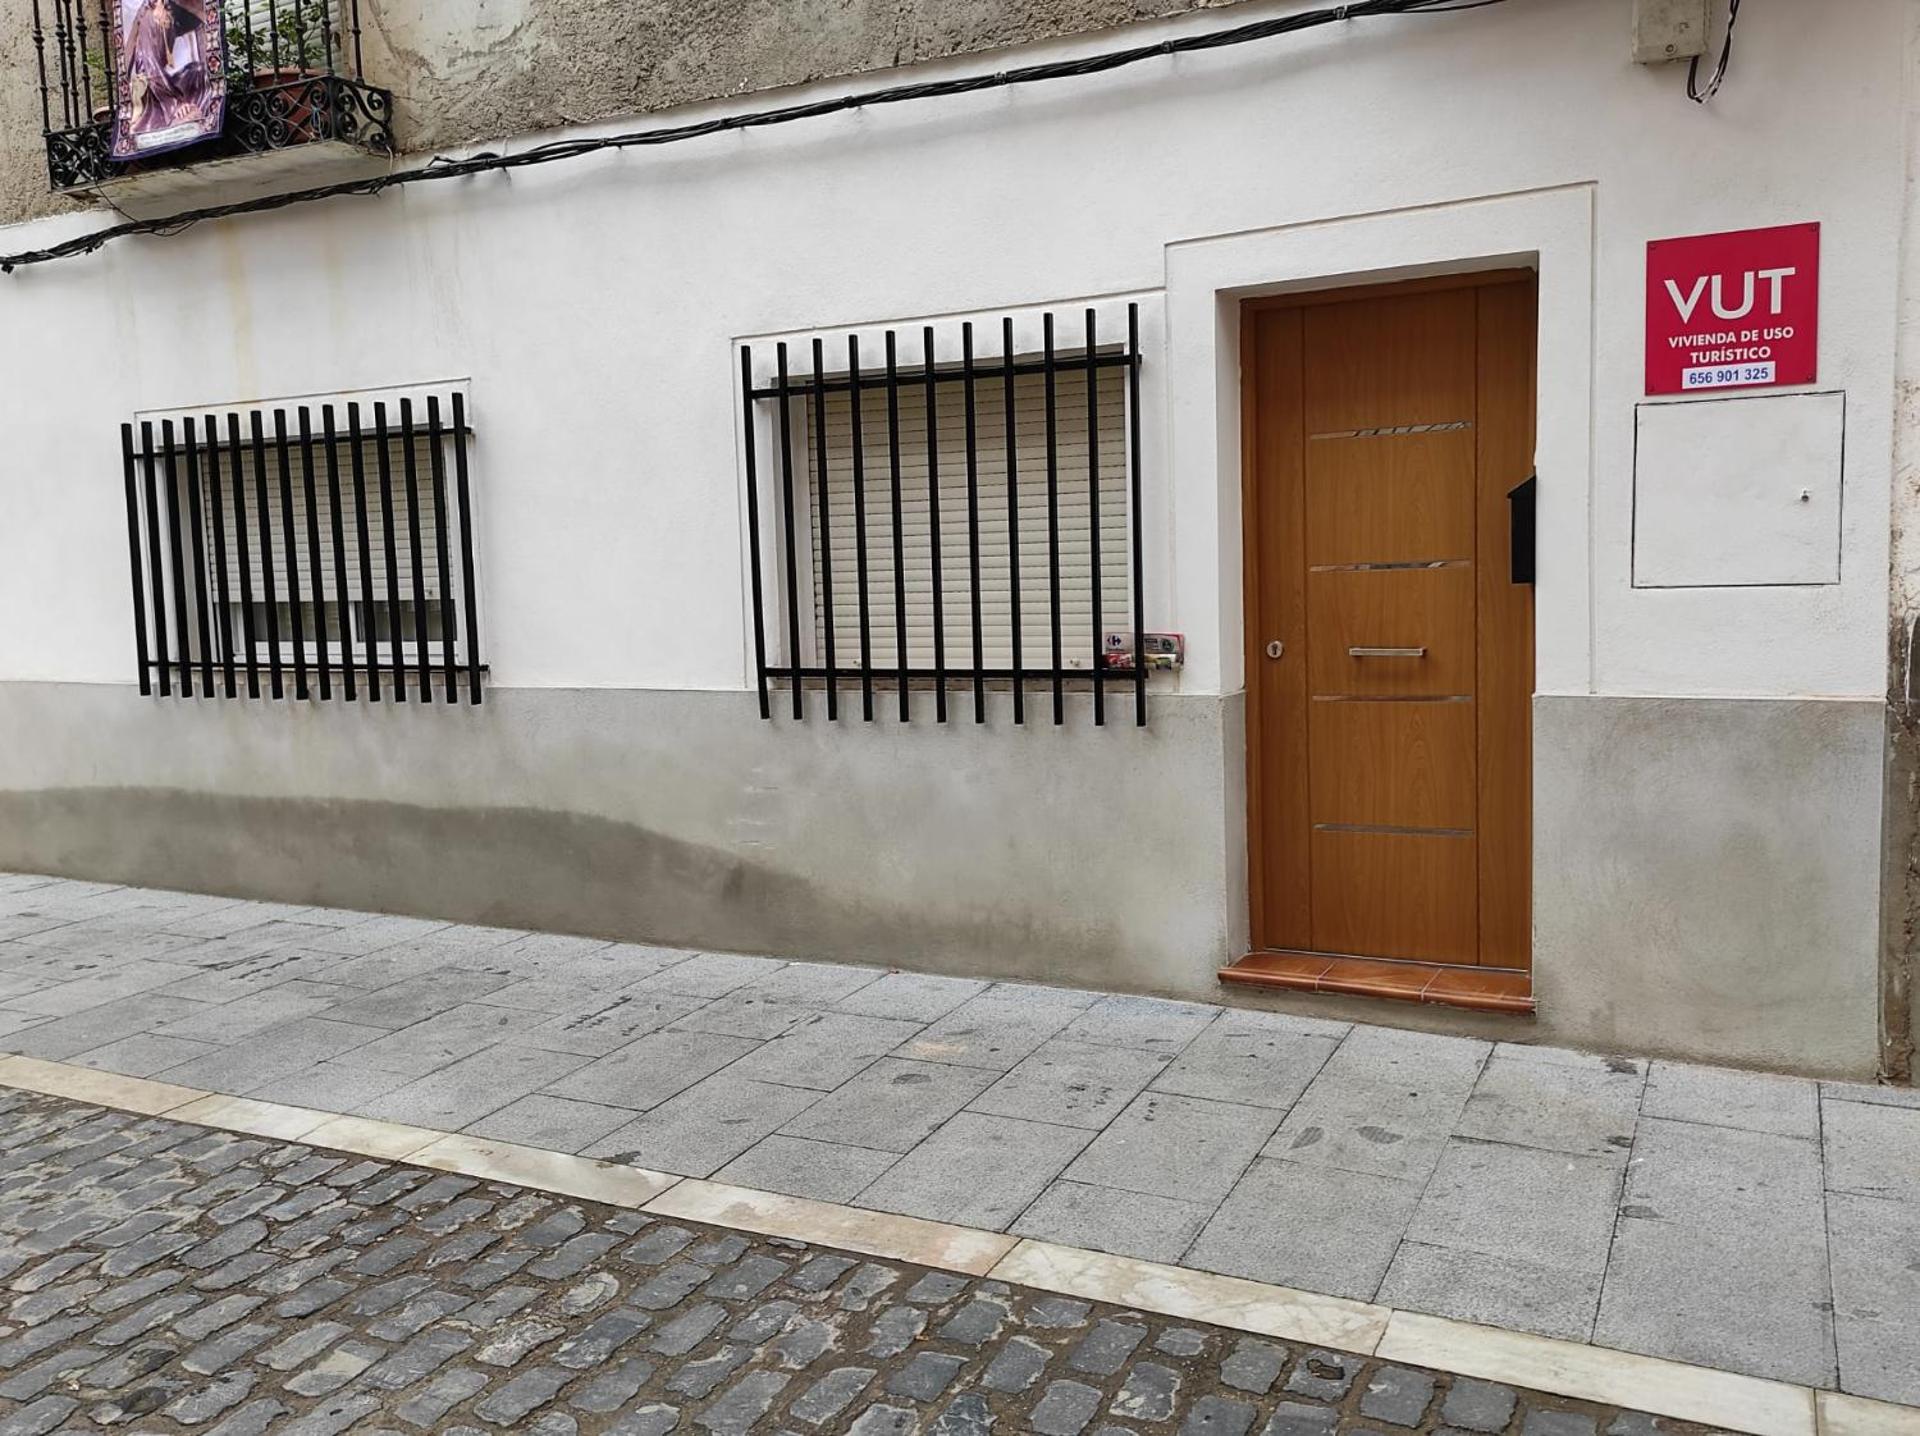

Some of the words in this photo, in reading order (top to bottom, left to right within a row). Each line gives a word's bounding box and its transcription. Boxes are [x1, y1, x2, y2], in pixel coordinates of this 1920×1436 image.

[1664, 267, 1795, 324] VUT
[1669, 331, 1736, 348] VIVIENDA
[1741, 329, 1759, 342] DE
[1763, 326, 1794, 340] USO
[1690, 346, 1771, 364] TURÍSTICO
[1689, 371, 1713, 385] 656
[1717, 369, 1740, 382] 901
[1744, 367, 1769, 380] 325
